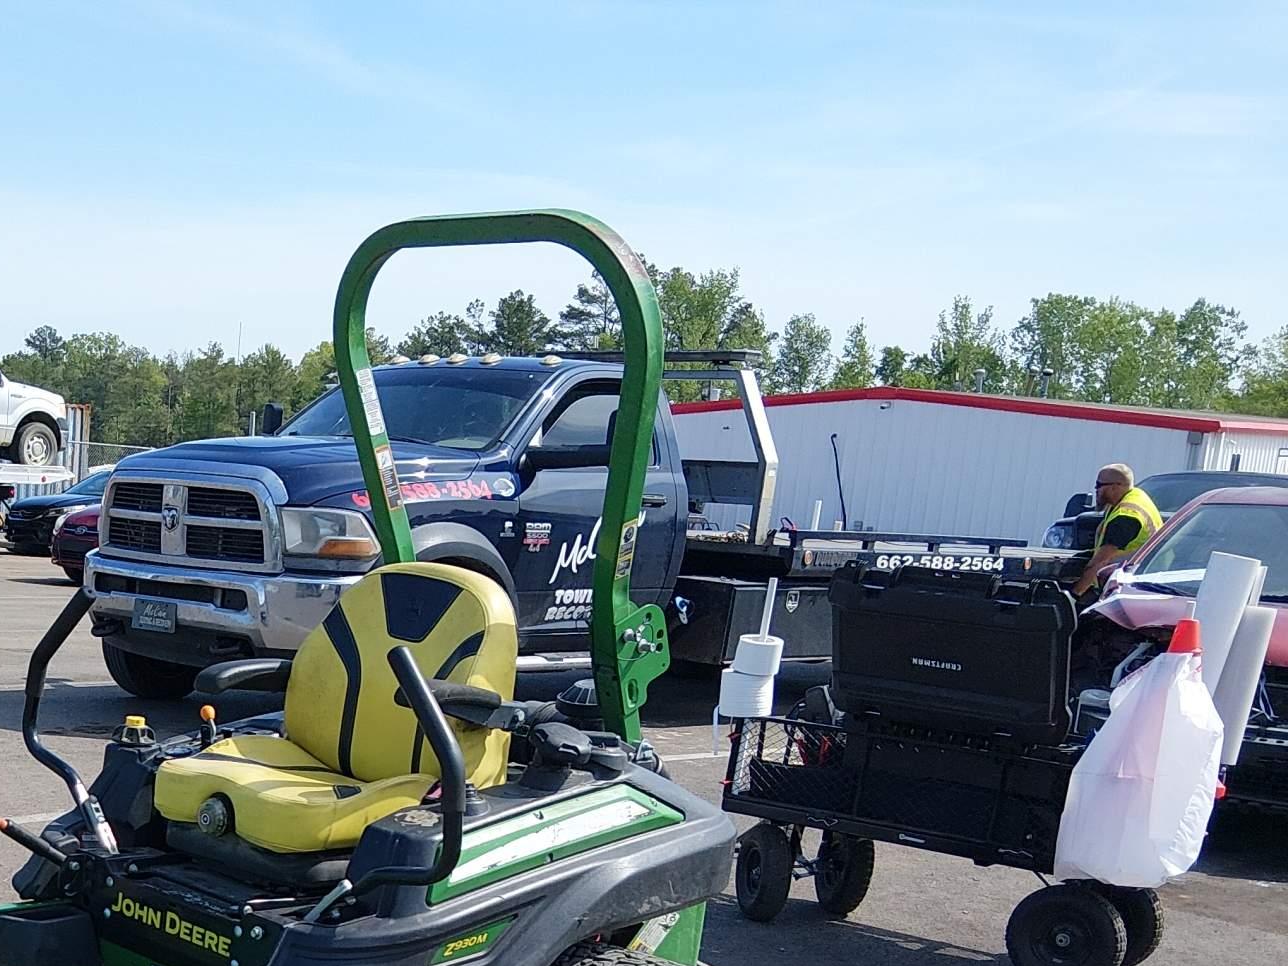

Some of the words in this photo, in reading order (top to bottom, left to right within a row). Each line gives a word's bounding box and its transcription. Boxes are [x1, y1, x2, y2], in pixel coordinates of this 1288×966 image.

[876, 555, 1004, 571] 662-588-2564
[912, 657, 962, 671] CRAFTSMAN
[111, 892, 162, 929] JOHN
[165, 911, 231, 957] DEERE
[443, 932, 488, 957] Z930M
